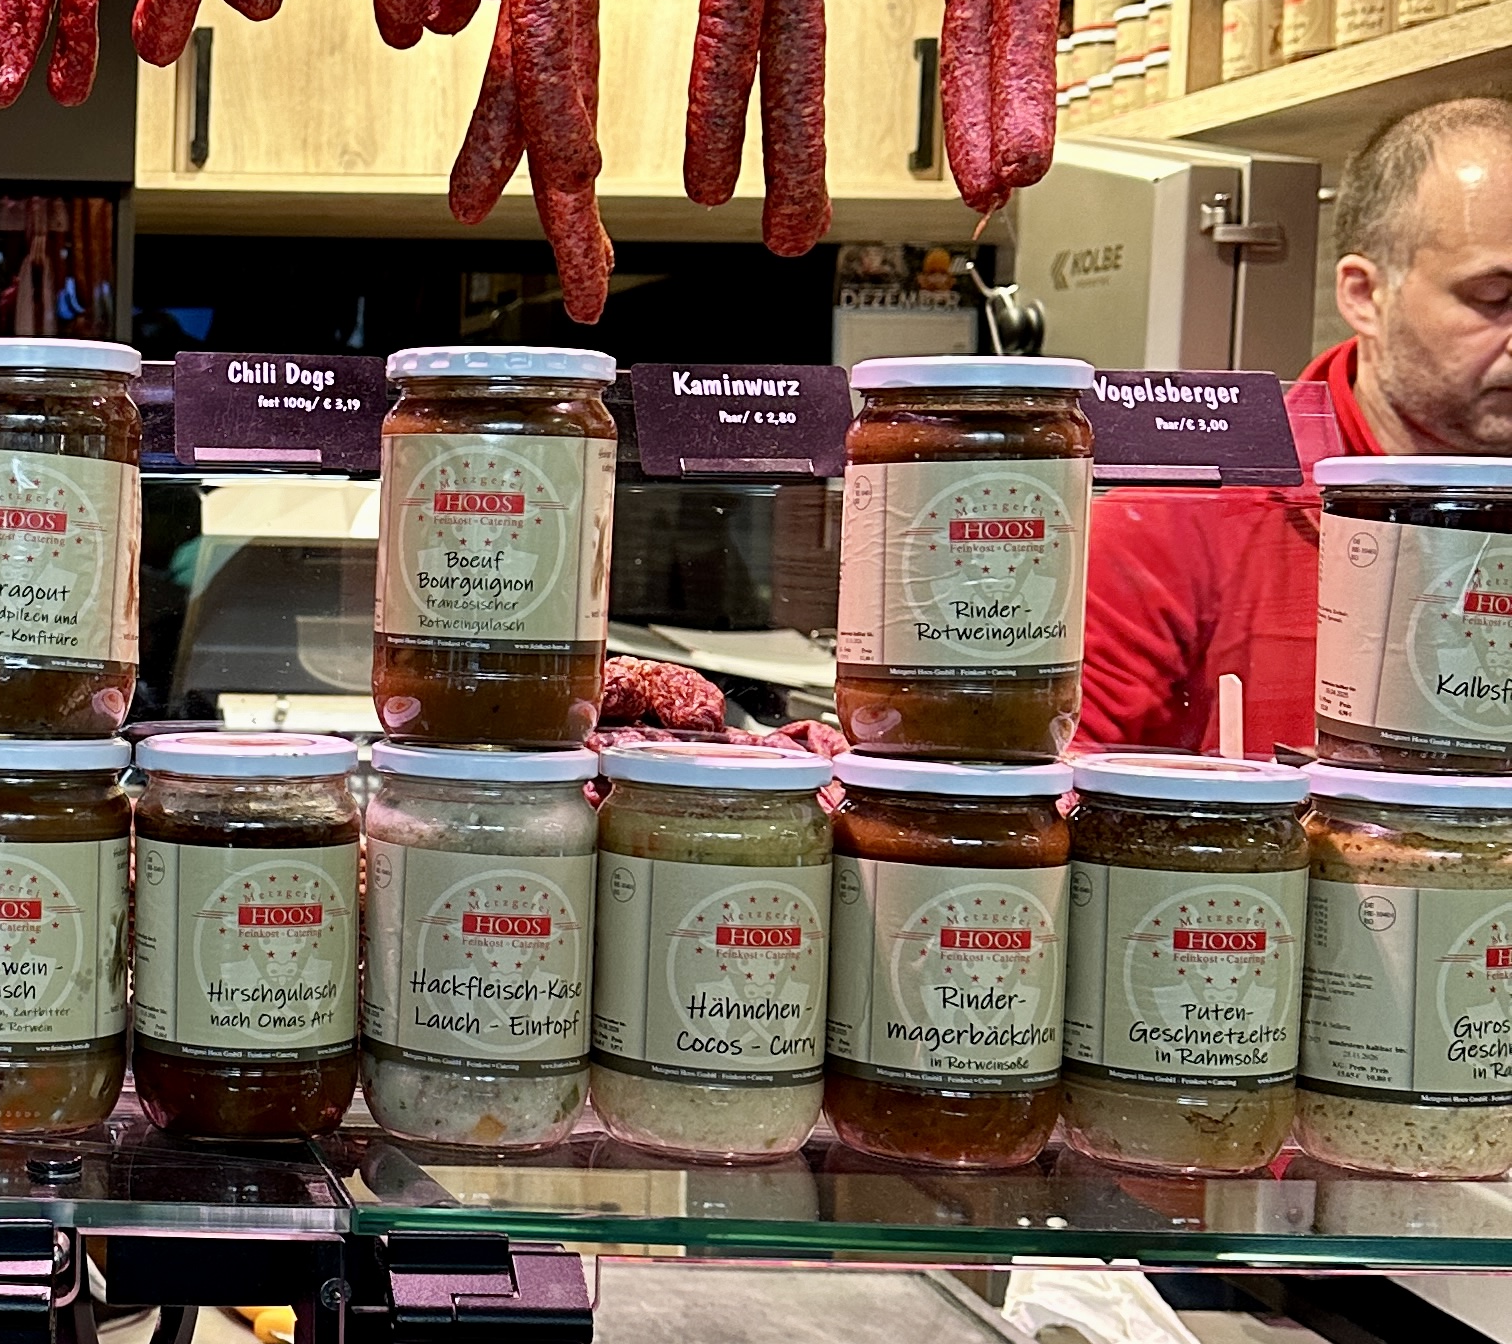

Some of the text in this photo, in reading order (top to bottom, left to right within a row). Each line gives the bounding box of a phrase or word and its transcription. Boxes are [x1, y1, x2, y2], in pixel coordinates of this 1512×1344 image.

[839, 286, 961, 311] DEZEMBER
[227, 360, 335, 392] Chili Dogs
[672, 371, 800, 397] Kaminwurz
[257, 394, 361, 412] fest 100g/ € 3,19
[1092, 375, 1240, 410] Vogelsberger
[754, 411, 763, 424] €
[766, 411, 797, 425] 2,80
[1197, 419, 1229, 432] 3,00
[445, 494, 514, 514] HOOS
[963, 521, 1035, 541] HOOS
[444, 550, 505, 571] Boeuf
[417, 572, 534, 598] Bourguignon
[54, 611, 78, 625] und
[418, 614, 525, 636] Rotweingulasch
[914, 621, 1067, 648] Rotweingulasch
[1437, 674, 1512, 702] Kalbsf
[252, 907, 314, 925] HOOS
[474, 916, 541, 936] HOOS
[729, 928, 794, 947] HOOS
[954, 930, 1024, 949] HOOS
[1188, 932, 1257, 950] HOOS
[207, 979, 337, 1009] Hirschgulasch
[410, 968, 582, 1000] Hackfleisch-Käse
[934, 986, 1026, 1010] Rinder-
[210, 1010, 335, 1029] nach Omas Art
[415, 1006, 480, 1034] Lauch
[509, 1009, 580, 1039] Eintopf
[1181, 1003, 1254, 1021] Puten-
[7, 1022, 53, 1033] Rotwein
[888, 1022, 1056, 1052] magerbäckchen
[1129, 1021, 1287, 1046] Geschnetzeltes
[676, 1030, 743, 1056] Cocos
[770, 1035, 816, 1057] Curry
[930, 1056, 1029, 1071] in Rotweinsoße
[1155, 1046, 1269, 1067] in Rahmsoße
